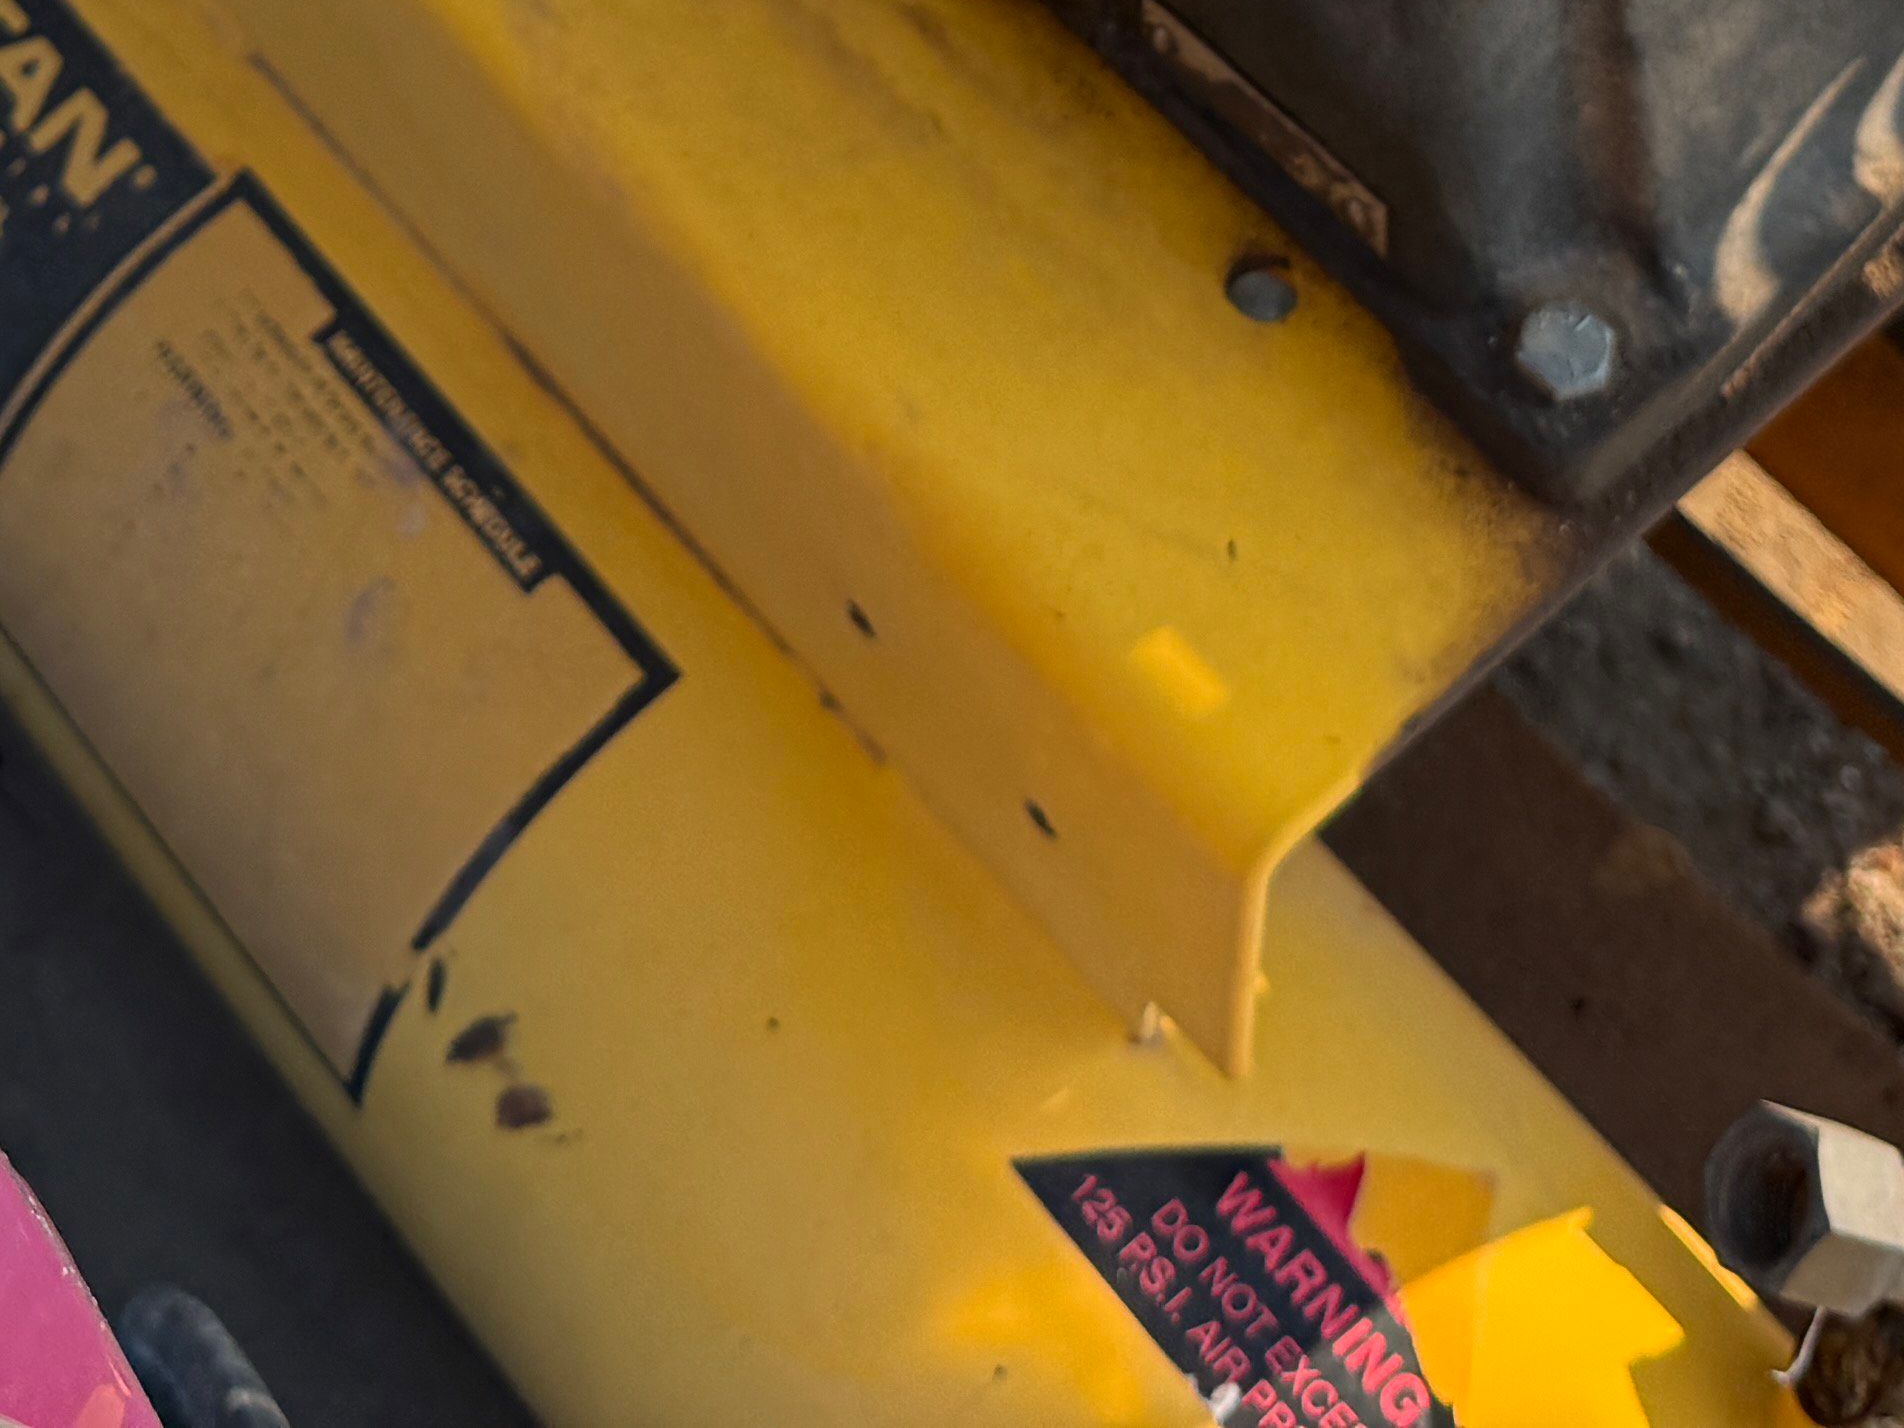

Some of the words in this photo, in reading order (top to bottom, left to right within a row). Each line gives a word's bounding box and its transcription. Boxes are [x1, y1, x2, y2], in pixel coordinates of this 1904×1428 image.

[1070, 1172, 1132, 1243] 125
[1186, 1320, 1252, 1384] AIR
[1151, 1197, 1209, 1263] DO
[1202, 1255, 1280, 1339] NOT
[1264, 1334, 1368, 1428] EXCE
[1215, 1170, 1431, 1428] WARNING
